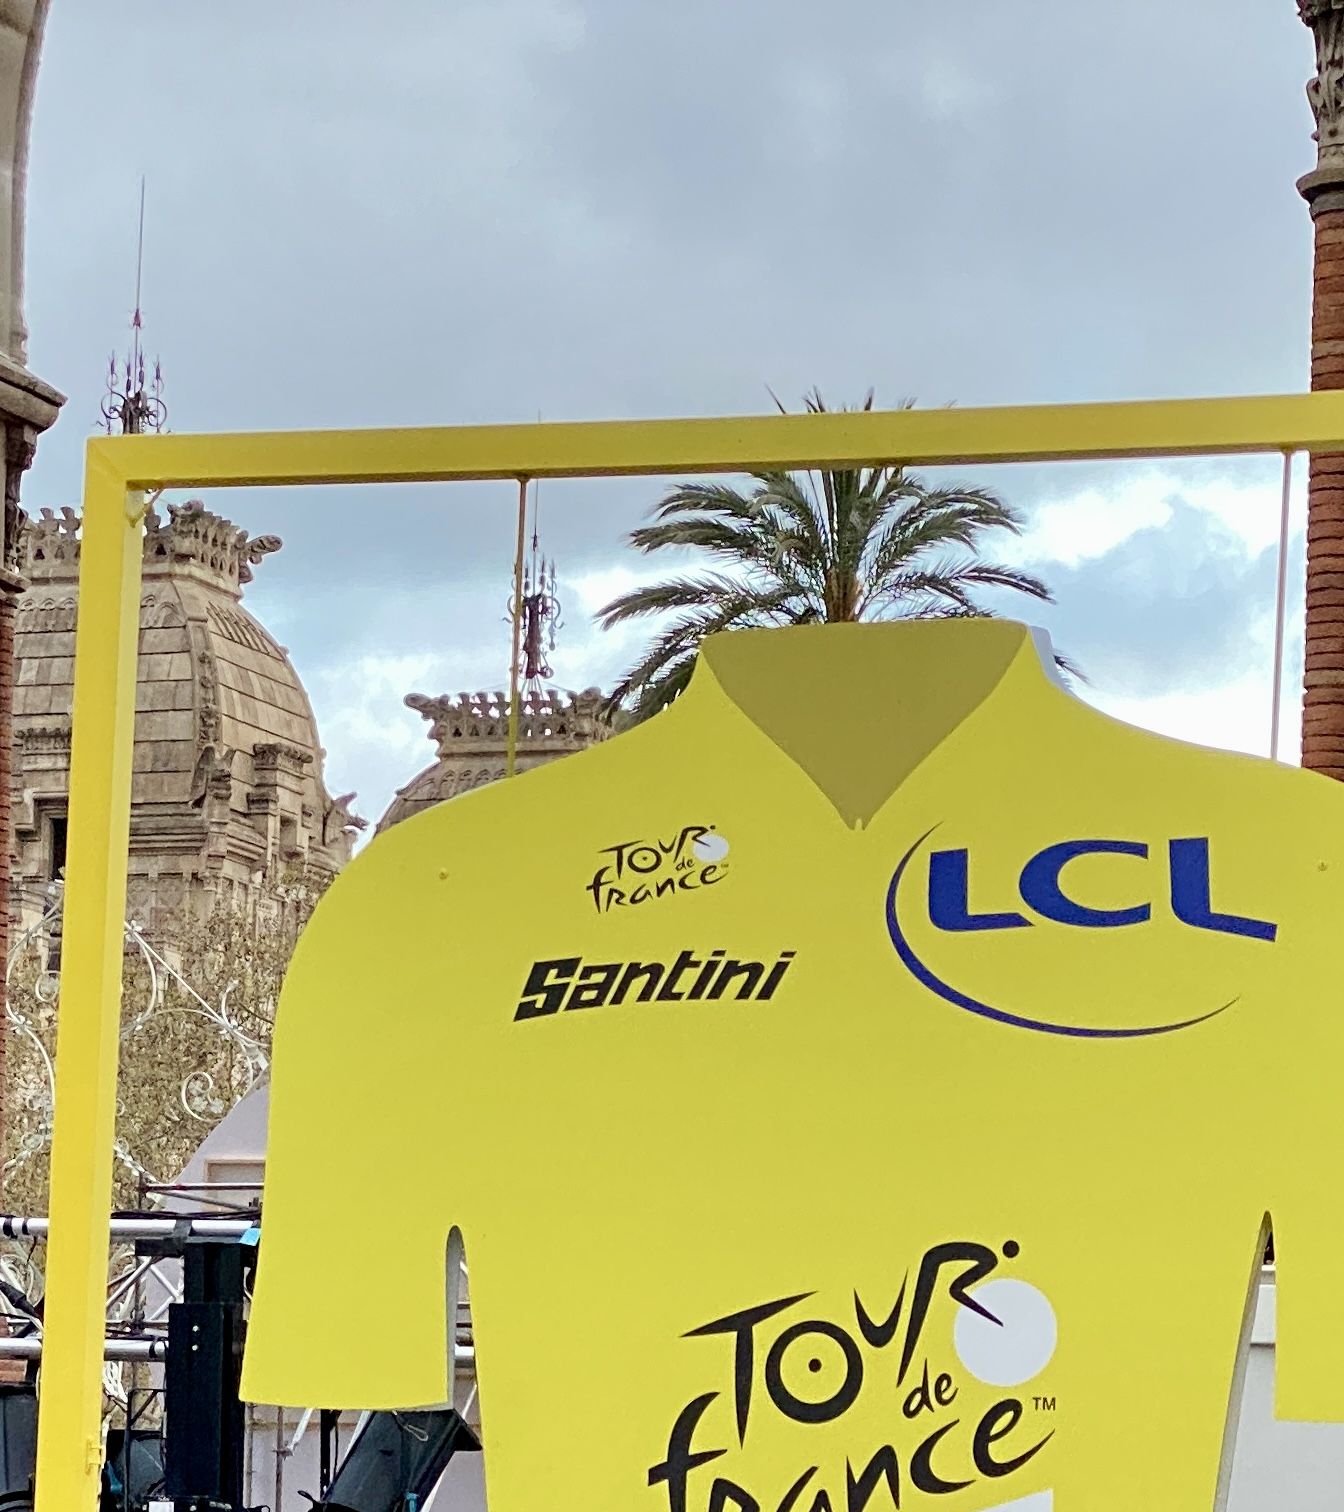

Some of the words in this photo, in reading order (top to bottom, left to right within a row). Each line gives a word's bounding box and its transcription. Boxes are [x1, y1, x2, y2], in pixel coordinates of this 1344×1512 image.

[675, 856, 695, 872] de
[928, 837, 1278, 943] LCL
[512, 949, 798, 1022] Santini
[903, 1359, 958, 1419] de
